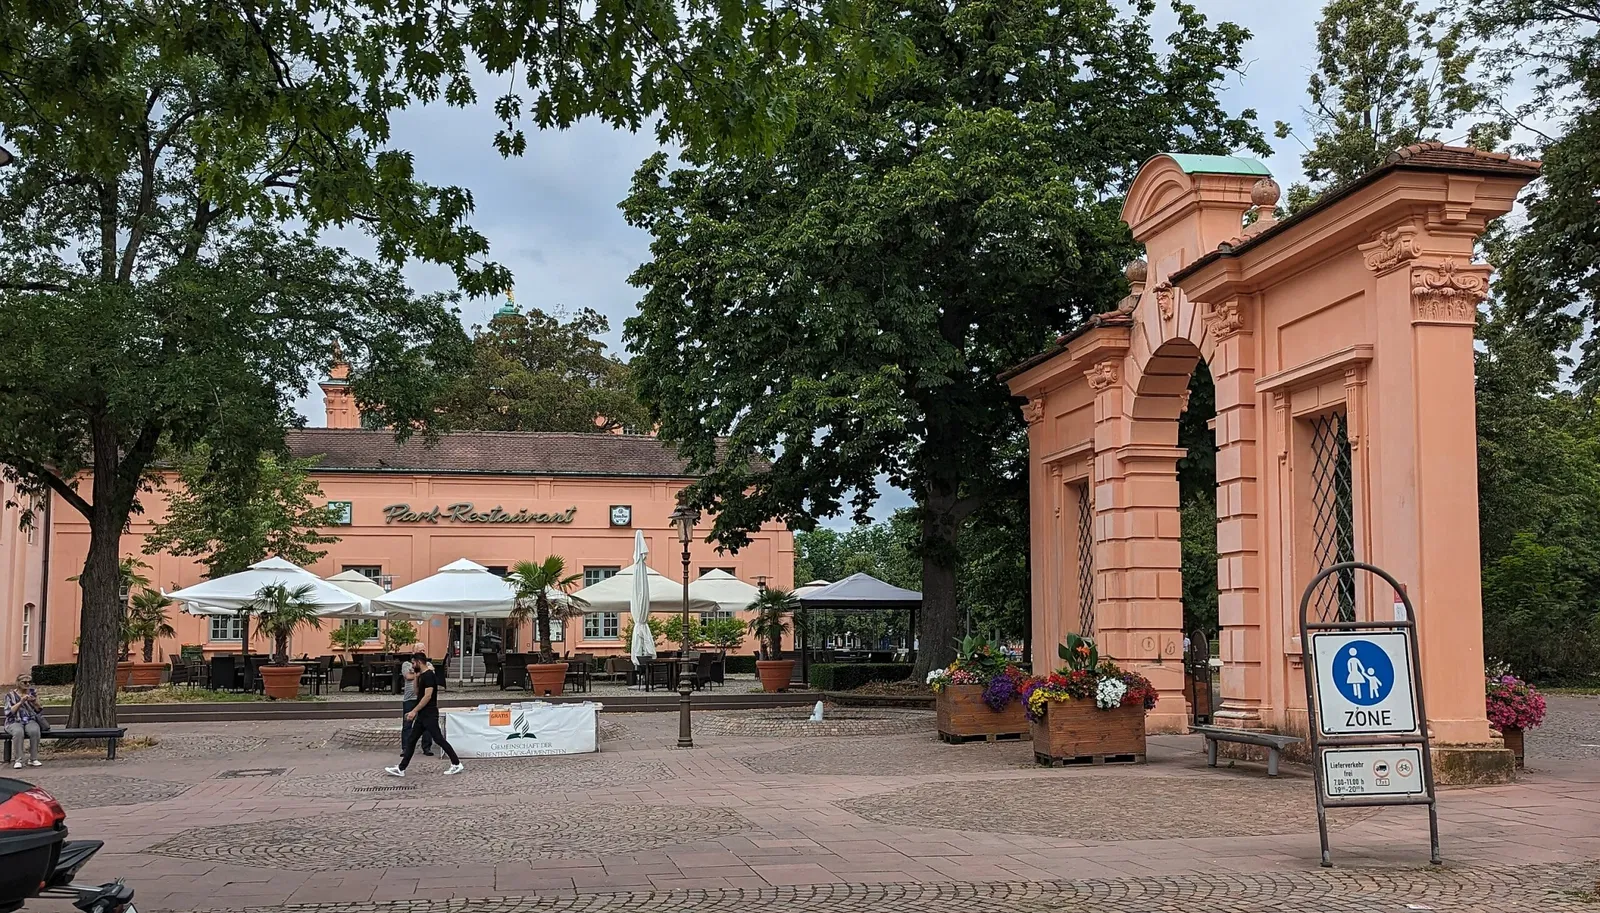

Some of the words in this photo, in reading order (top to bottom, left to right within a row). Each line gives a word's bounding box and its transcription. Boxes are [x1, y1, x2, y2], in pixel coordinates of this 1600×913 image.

[382, 502, 577, 524] Park-Restaurant
[1344, 710, 1392, 727] ZONE
[1330, 761, 1364, 769] Lieferverkehr
